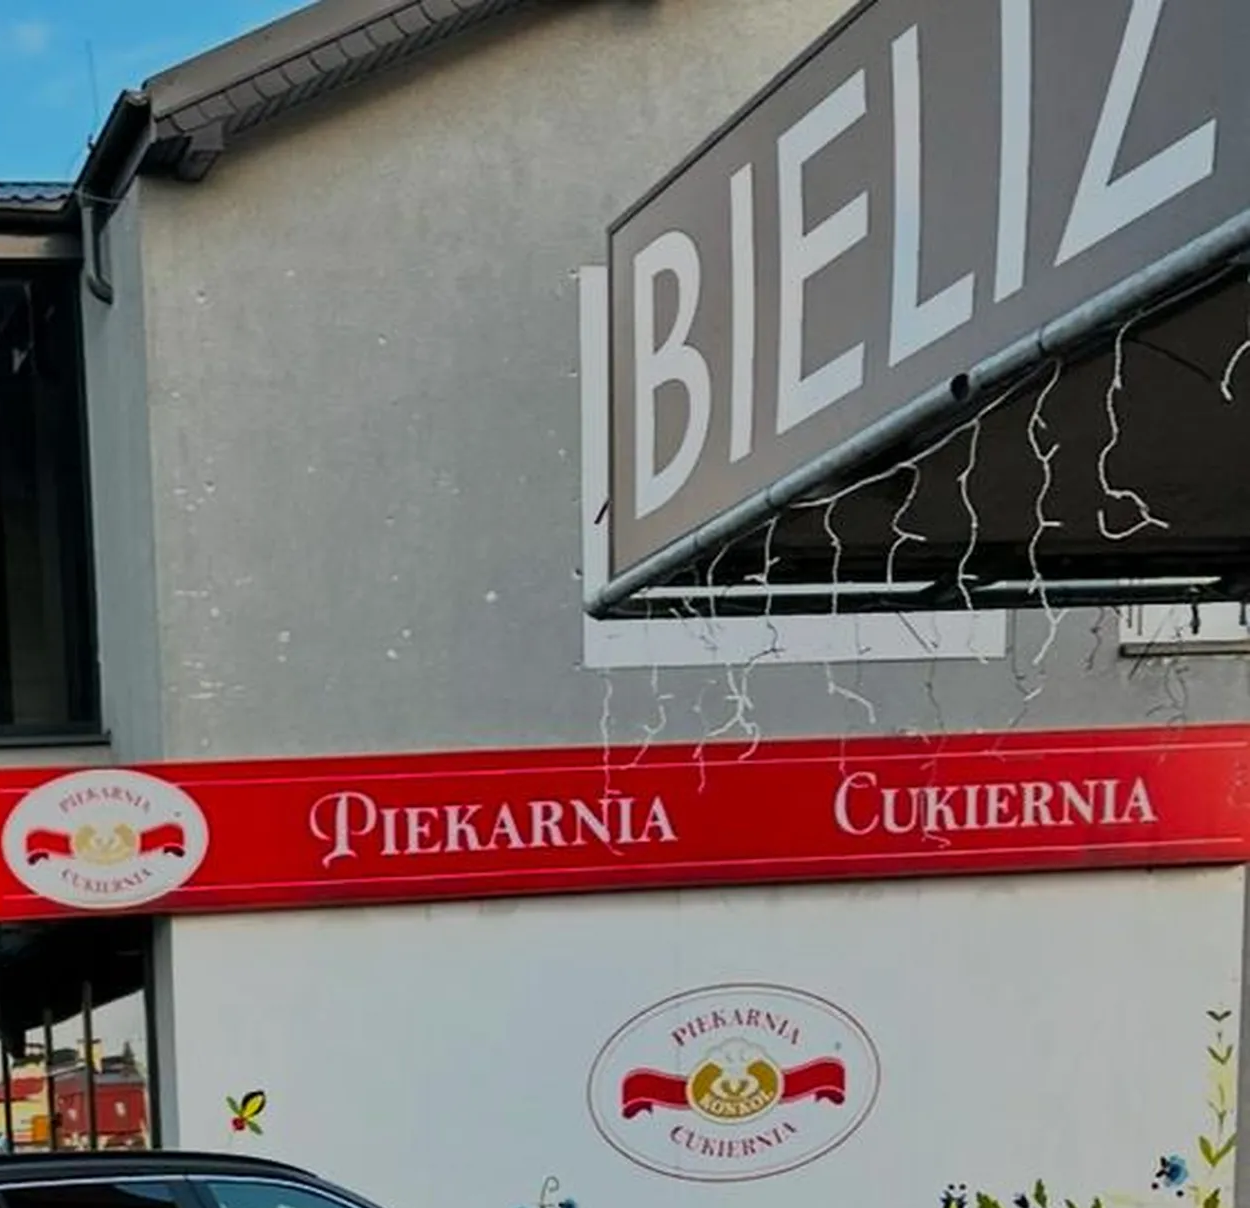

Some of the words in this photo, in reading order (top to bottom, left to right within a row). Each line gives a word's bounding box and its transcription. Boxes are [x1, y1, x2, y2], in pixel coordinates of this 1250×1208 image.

[58, 786, 150, 814] PIEKARNIA
[309, 790, 678, 868] PIEKARNIA
[834, 771, 1159, 836] CUKIERNIA
[60, 867, 152, 894] CUKIERNIA
[670, 1008, 800, 1047] PIEKARNIA
[669, 1121, 798, 1159] CUKIERNIA
